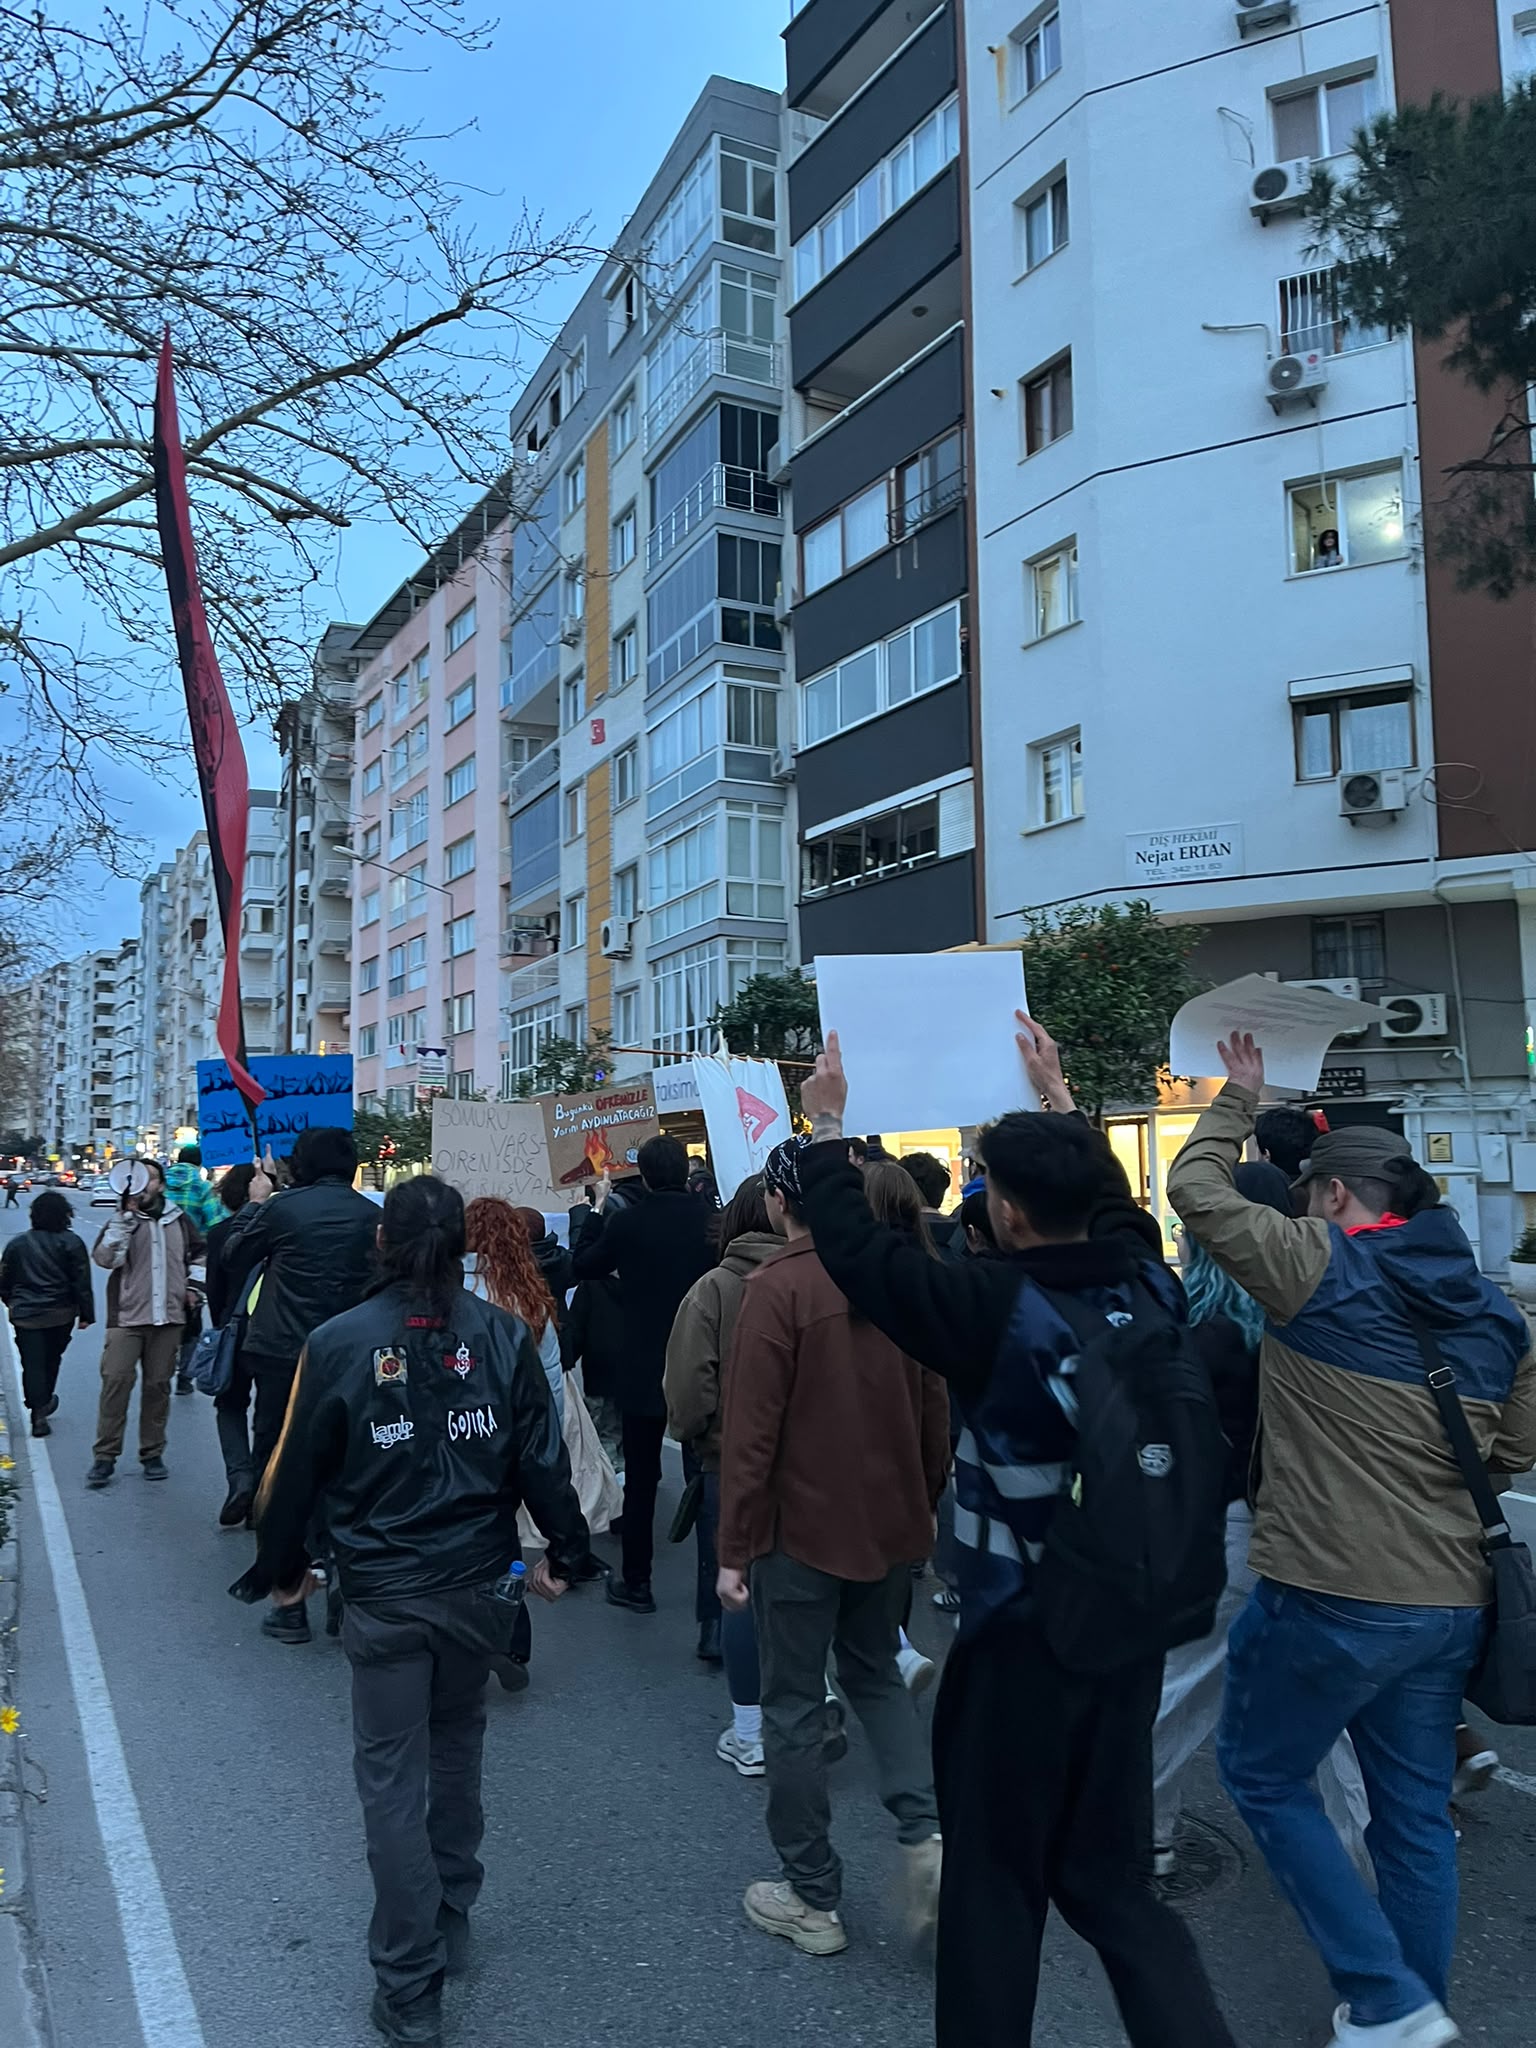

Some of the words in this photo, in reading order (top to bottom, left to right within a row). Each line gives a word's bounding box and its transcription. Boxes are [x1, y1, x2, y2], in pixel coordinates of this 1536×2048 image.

[1136, 850, 1175, 867] Nejat
[1179, 842, 1231, 860] ERTAN
[581, 1105, 655, 1130] AYDINLATACAĞIZ
[448, 1404, 498, 1441] GOJIRA
